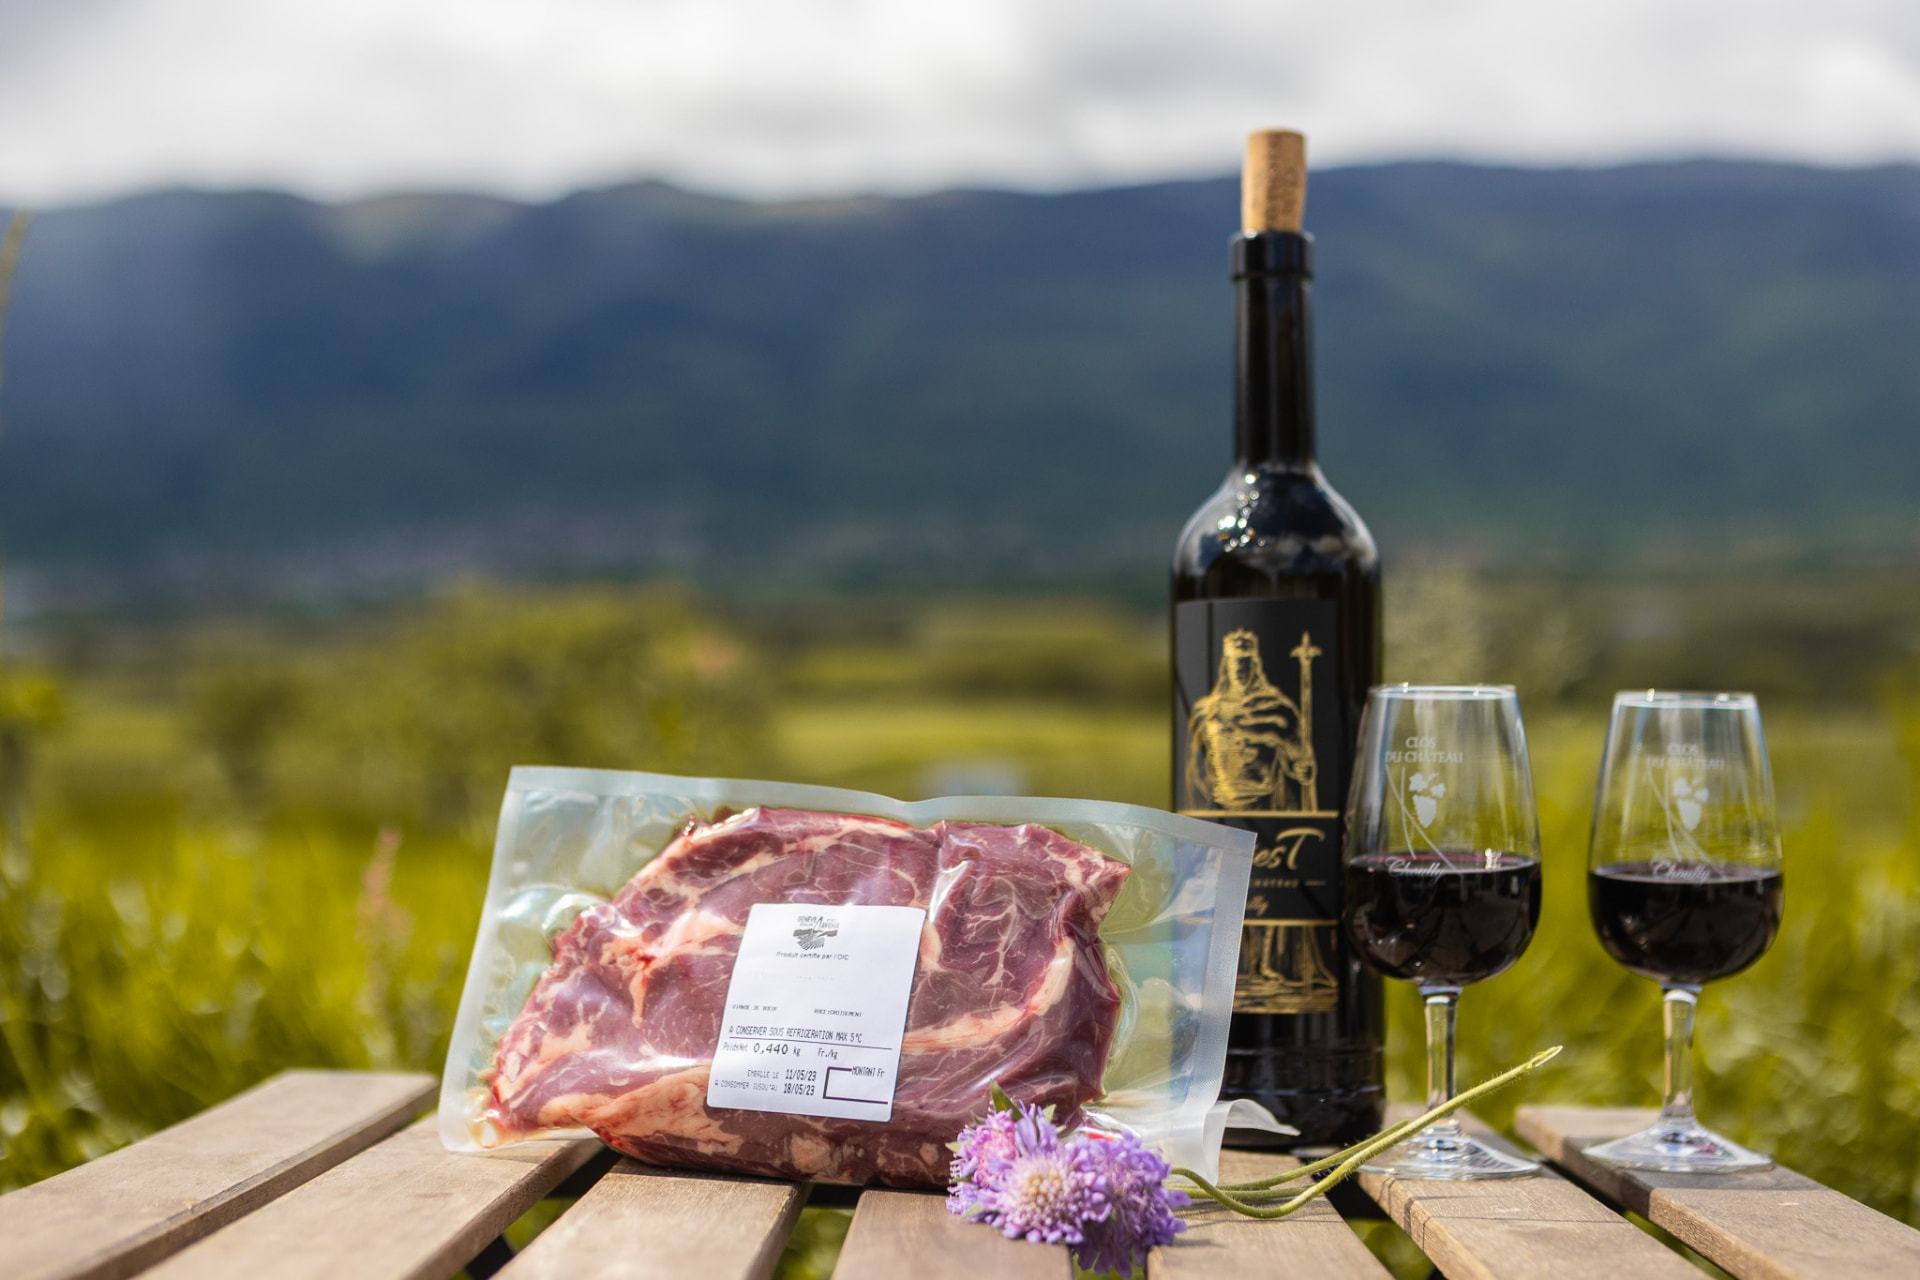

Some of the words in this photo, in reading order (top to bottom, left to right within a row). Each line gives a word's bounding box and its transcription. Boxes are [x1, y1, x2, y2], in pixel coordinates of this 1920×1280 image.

[1405, 736, 1437, 748] CLOS
[1384, 752, 1401, 763] DU
[1253, 827, 1326, 870] esT
[776, 951, 799, 959] Produit
[821, 953, 833, 961] par
[736, 1025, 767, 1036] CONSERVER
[770, 1027, 784, 1037] SOUS
[786, 1028, 833, 1040] REFRIGERATION
[836, 1032, 848, 1042] MAX
[850, 1033, 862, 1043] 5°C
[753, 1042, 789, 1055] 0,440
[793, 1045, 800, 1056] kg
[785, 1069, 817, 1082] 11/05/23
[851, 1065, 876, 1077] MONTANT
[876, 1068, 885, 1078] Fr
[721, 1080, 750, 1089] CONSOMMER
[783, 1083, 815, 1097] 18/05/23
